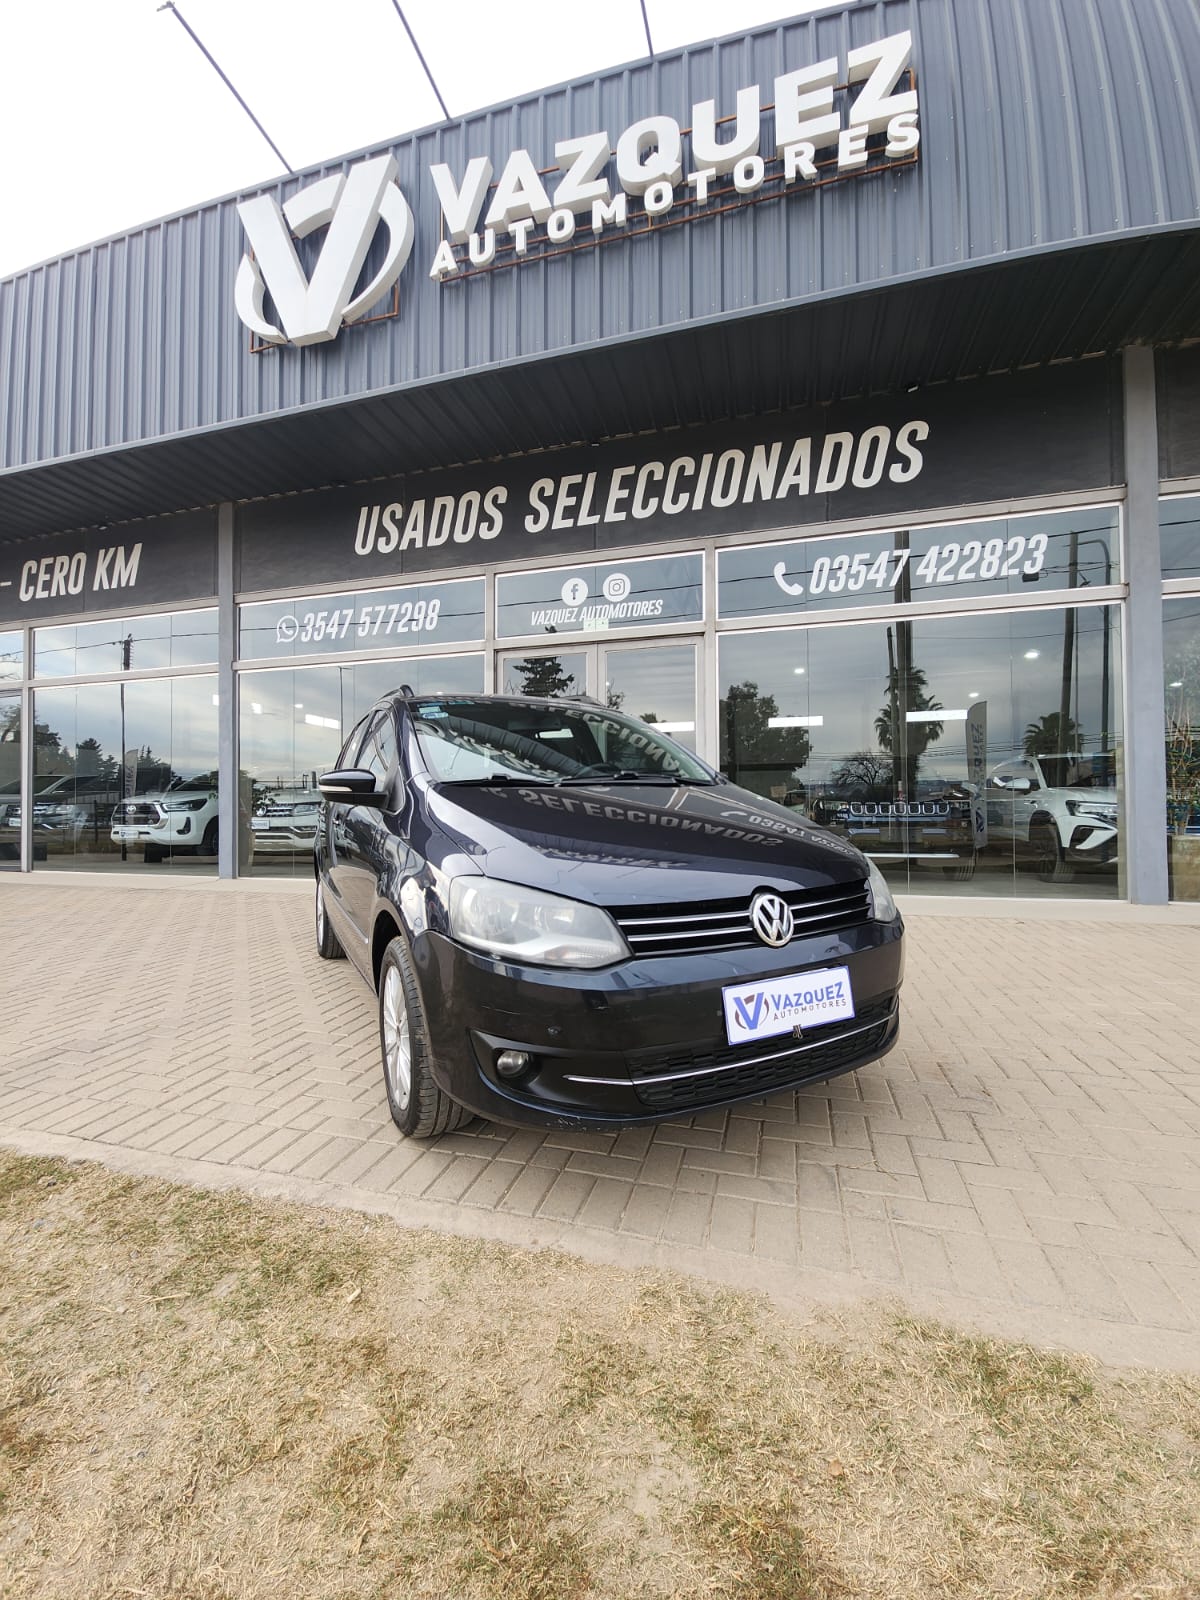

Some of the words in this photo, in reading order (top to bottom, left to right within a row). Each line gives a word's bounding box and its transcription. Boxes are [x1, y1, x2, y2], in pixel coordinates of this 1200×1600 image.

[429, 30, 918, 243] VAZQUEZ
[430, 113, 920, 280] AUTOMOTORES
[355, 486, 508, 556] USADOS
[524, 420, 929, 534] SELECCIONADOS
[19, 552, 87, 602] CERO
[93, 542, 143, 591] KM
[809, 549, 910, 594] 03547
[916, 533, 1048, 583] 422823
[301, 609, 354, 642] 3547
[358, 599, 441, 637] 577298
[531, 607, 577, 626] VAZQUEZ
[579, 599, 663, 621] AUTOMOTORES
[771, 981, 844, 1011] VAZQUEZ
[773, 998, 847, 1022] AUTOMOTORES
